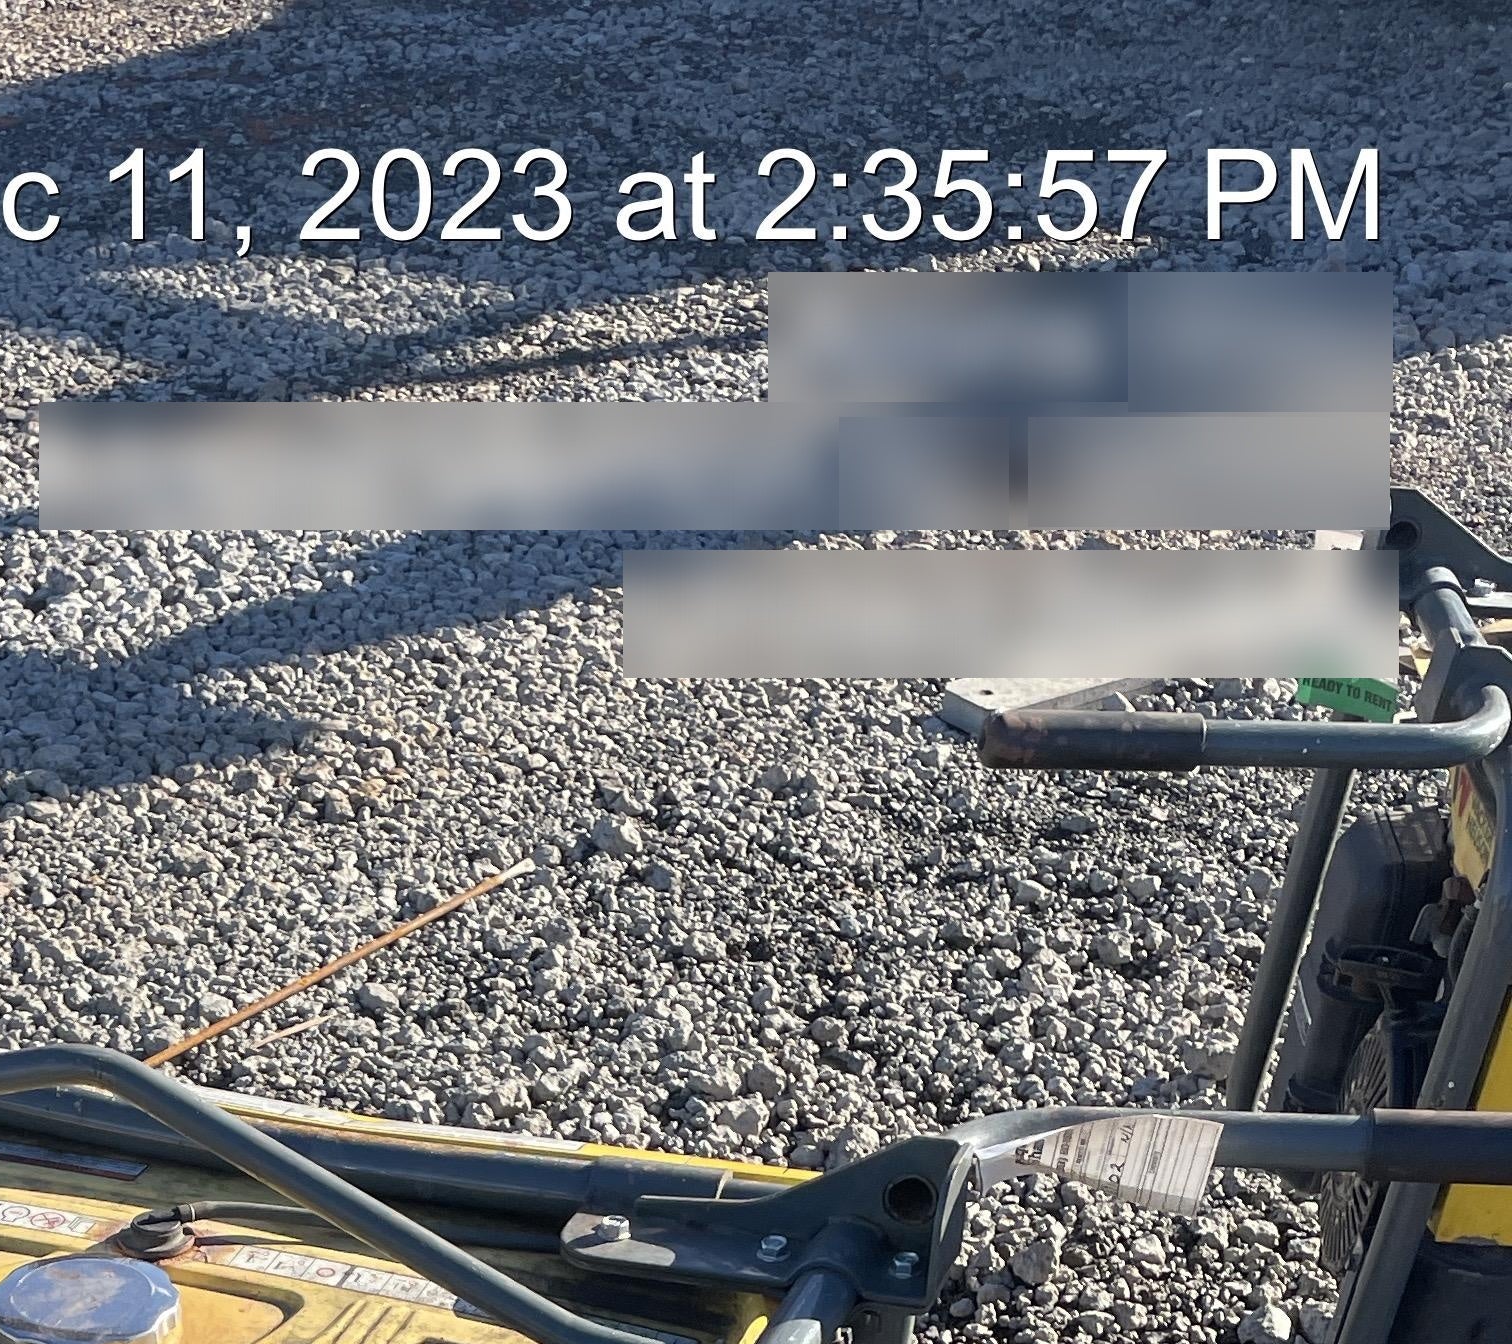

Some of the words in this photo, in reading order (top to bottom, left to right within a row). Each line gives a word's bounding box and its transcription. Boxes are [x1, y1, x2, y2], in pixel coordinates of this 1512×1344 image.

[1302, 678, 1344, 694] READY
[1346, 684, 1361, 699] TO
[1364, 690, 1392, 712] RENT
